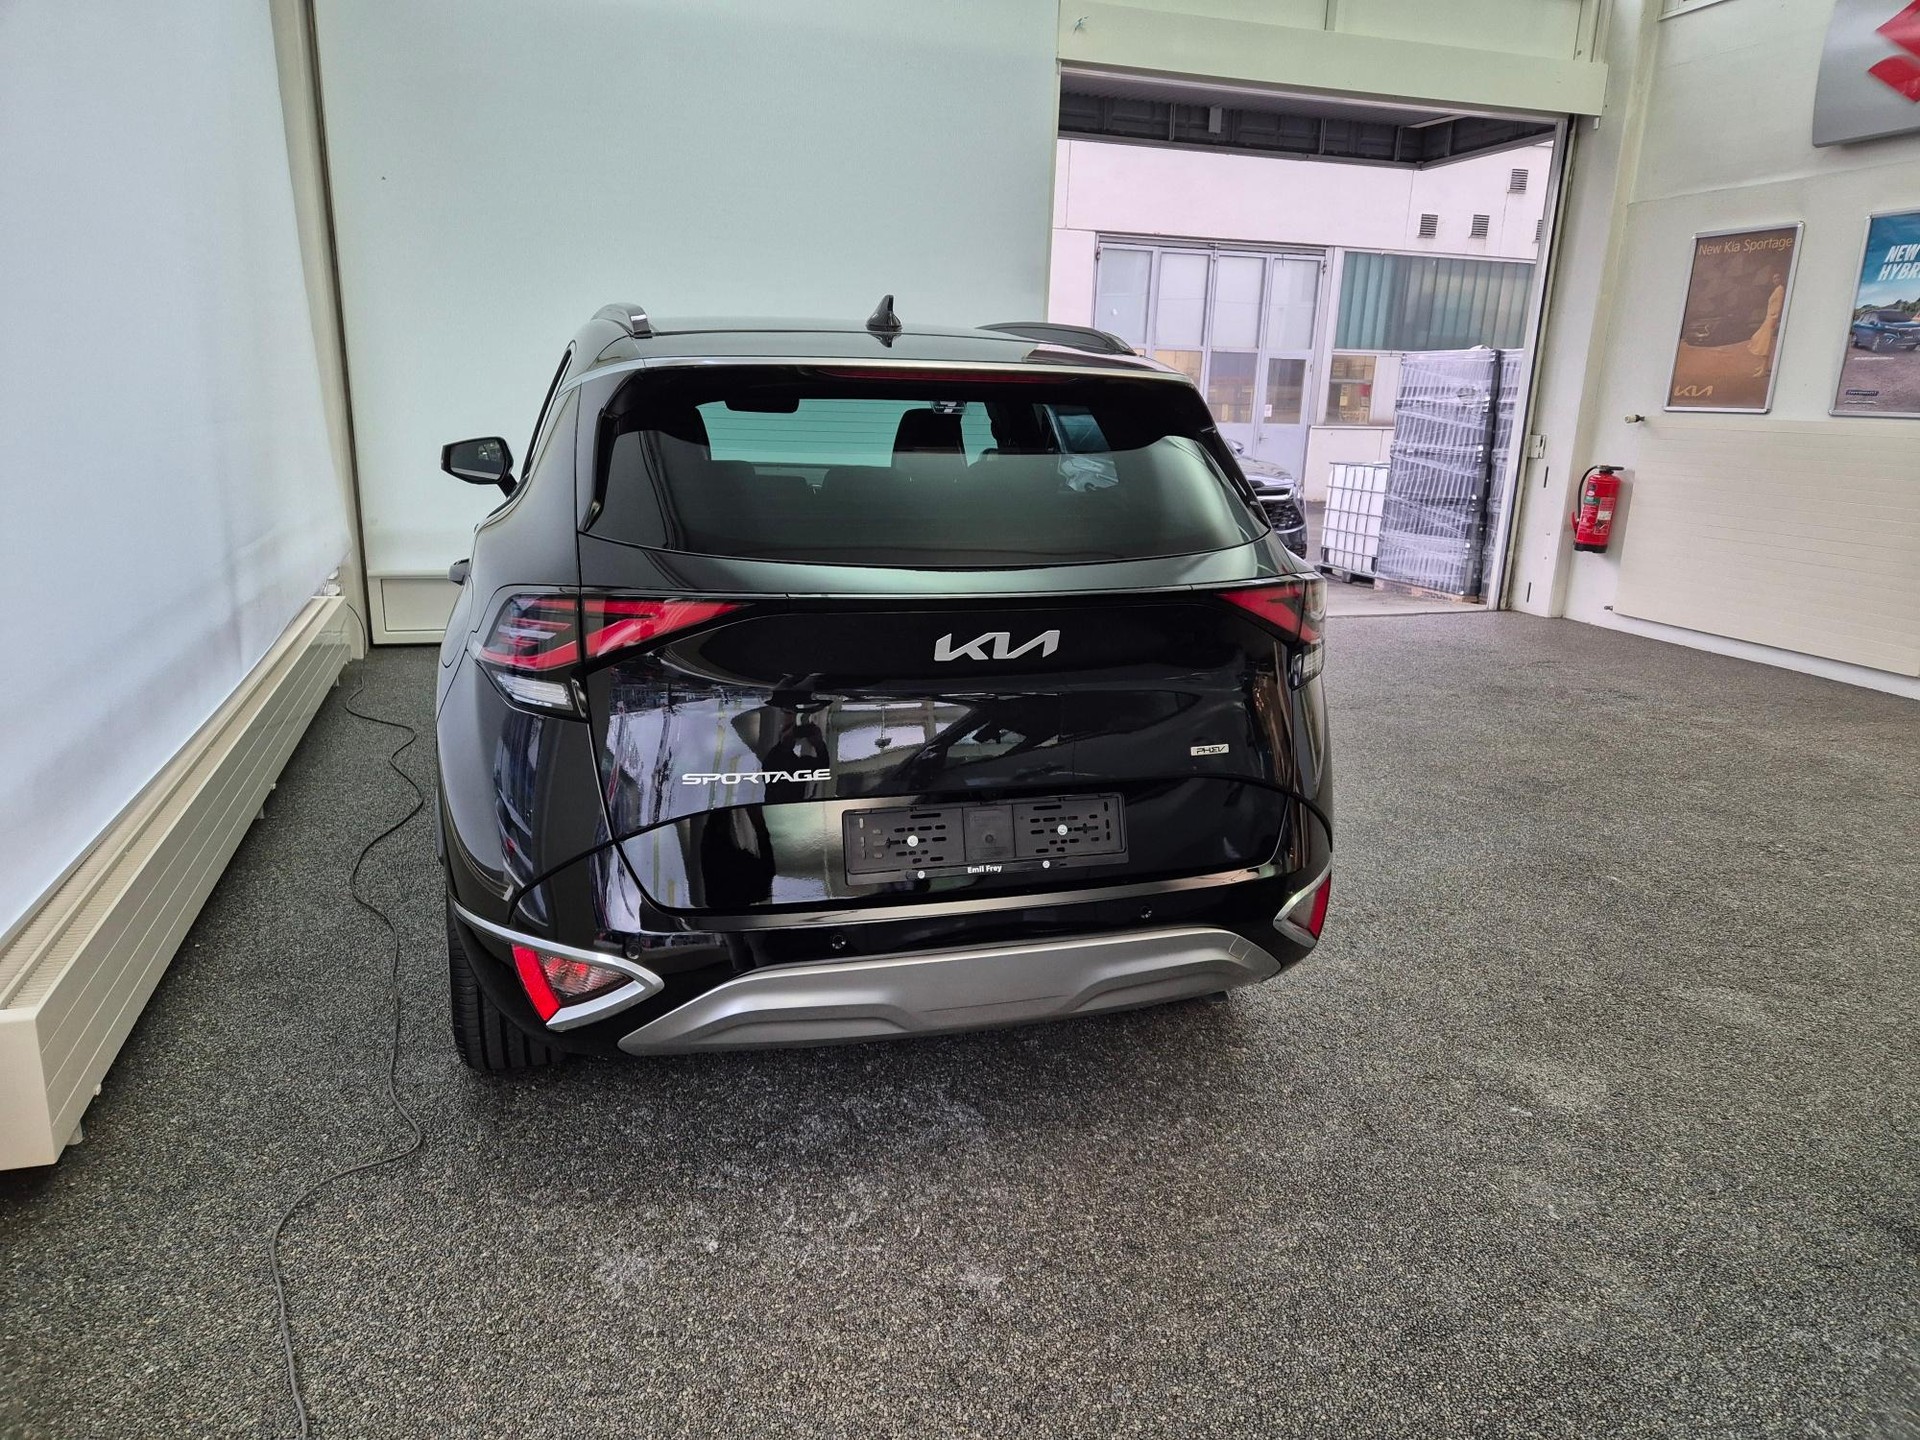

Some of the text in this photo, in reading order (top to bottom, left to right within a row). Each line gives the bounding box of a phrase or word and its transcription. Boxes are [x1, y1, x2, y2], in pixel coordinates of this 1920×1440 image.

[1698, 236, 1793, 255] New Kia Sportage
[1884, 243, 1920, 262] NEW
[1877, 262, 1920, 281] HYBR
[934, 629, 1061, 662] KIA
[1196, 745, 1226, 755] PHEV
[682, 768, 832, 786] SPORTAGE
[967, 864, 1002, 874] Emil Frey
